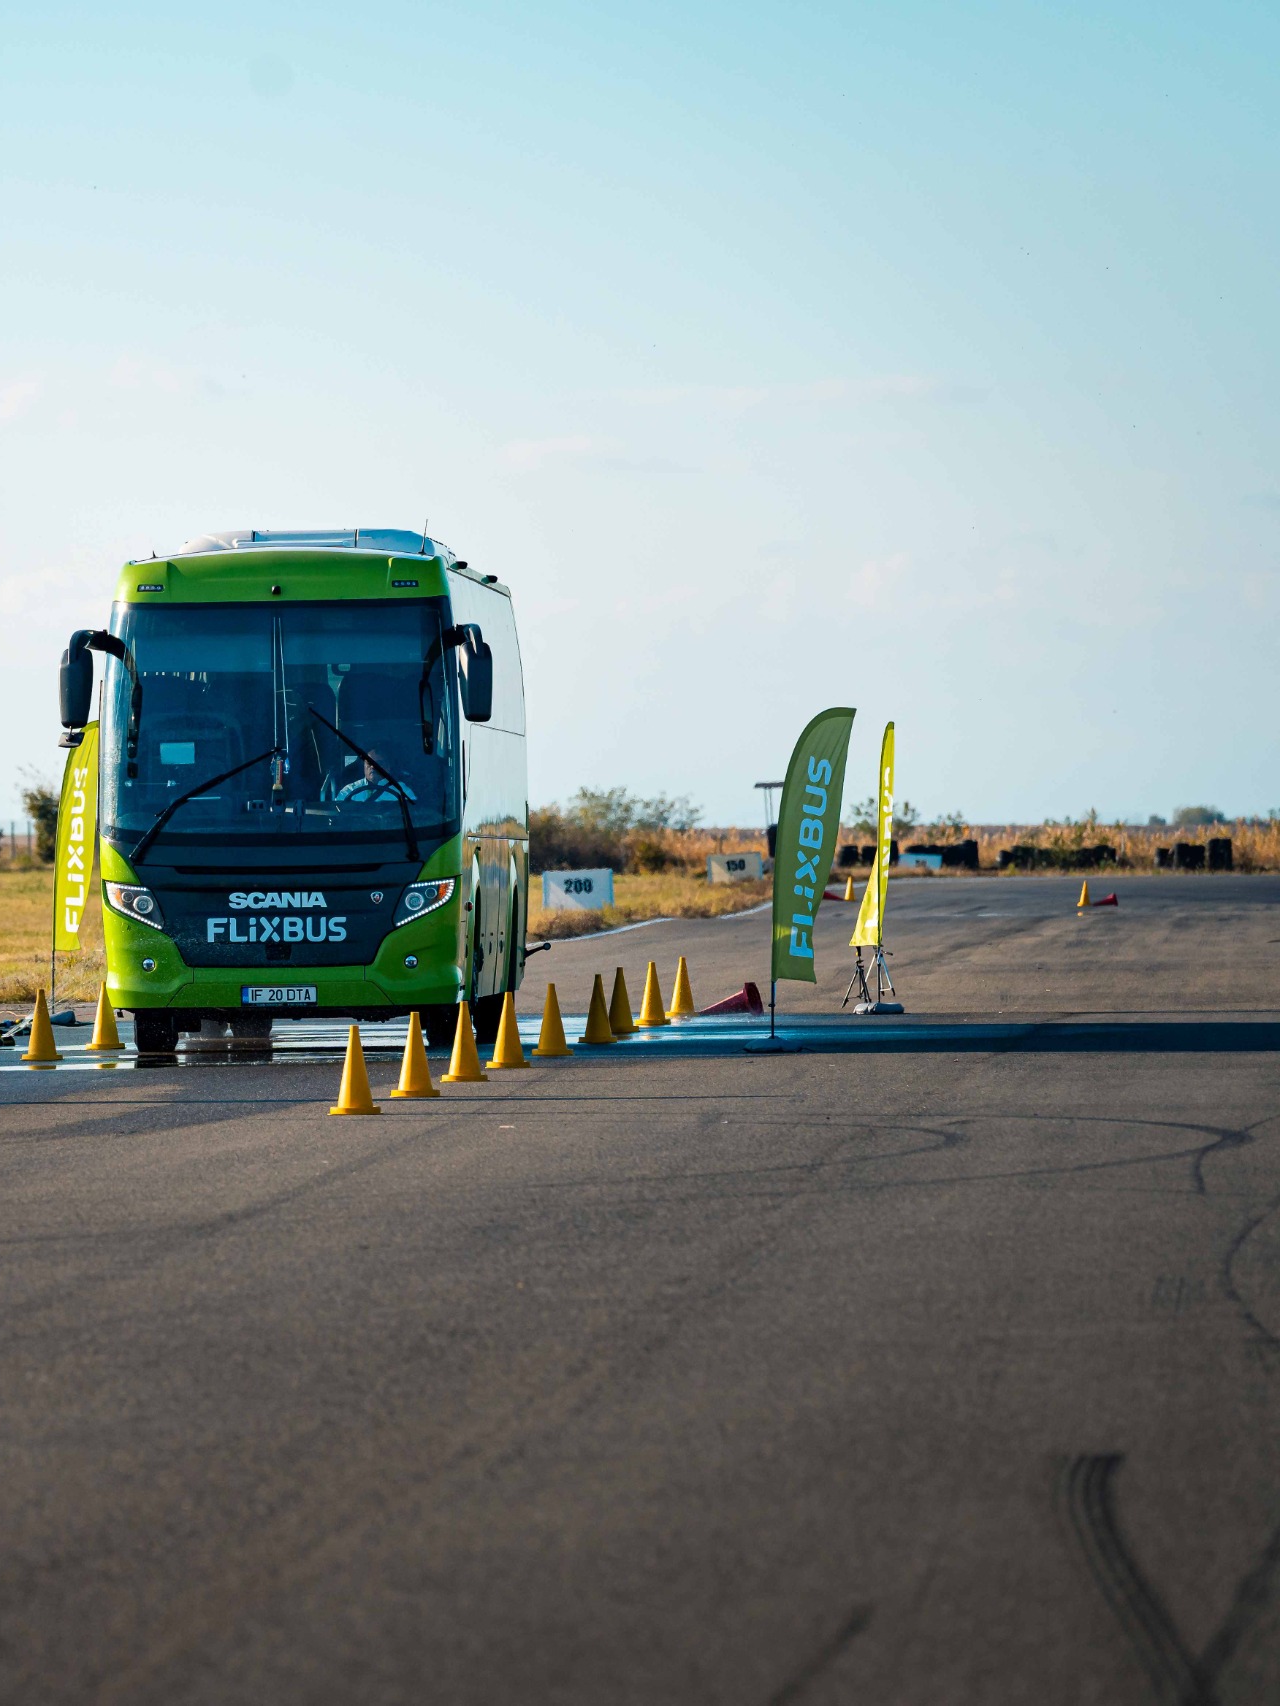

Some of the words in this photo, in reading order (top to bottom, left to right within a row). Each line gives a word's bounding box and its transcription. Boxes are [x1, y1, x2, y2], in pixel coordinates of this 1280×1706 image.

[726, 859, 746, 872] 150
[564, 878, 593, 894] 200
[228, 892, 327, 910] SCANIA
[207, 916, 347, 942] FLiXBUS
[251, 989, 263, 1002] IF
[268, 989, 283, 1001] 20
[287, 989, 311, 1001] DTA
